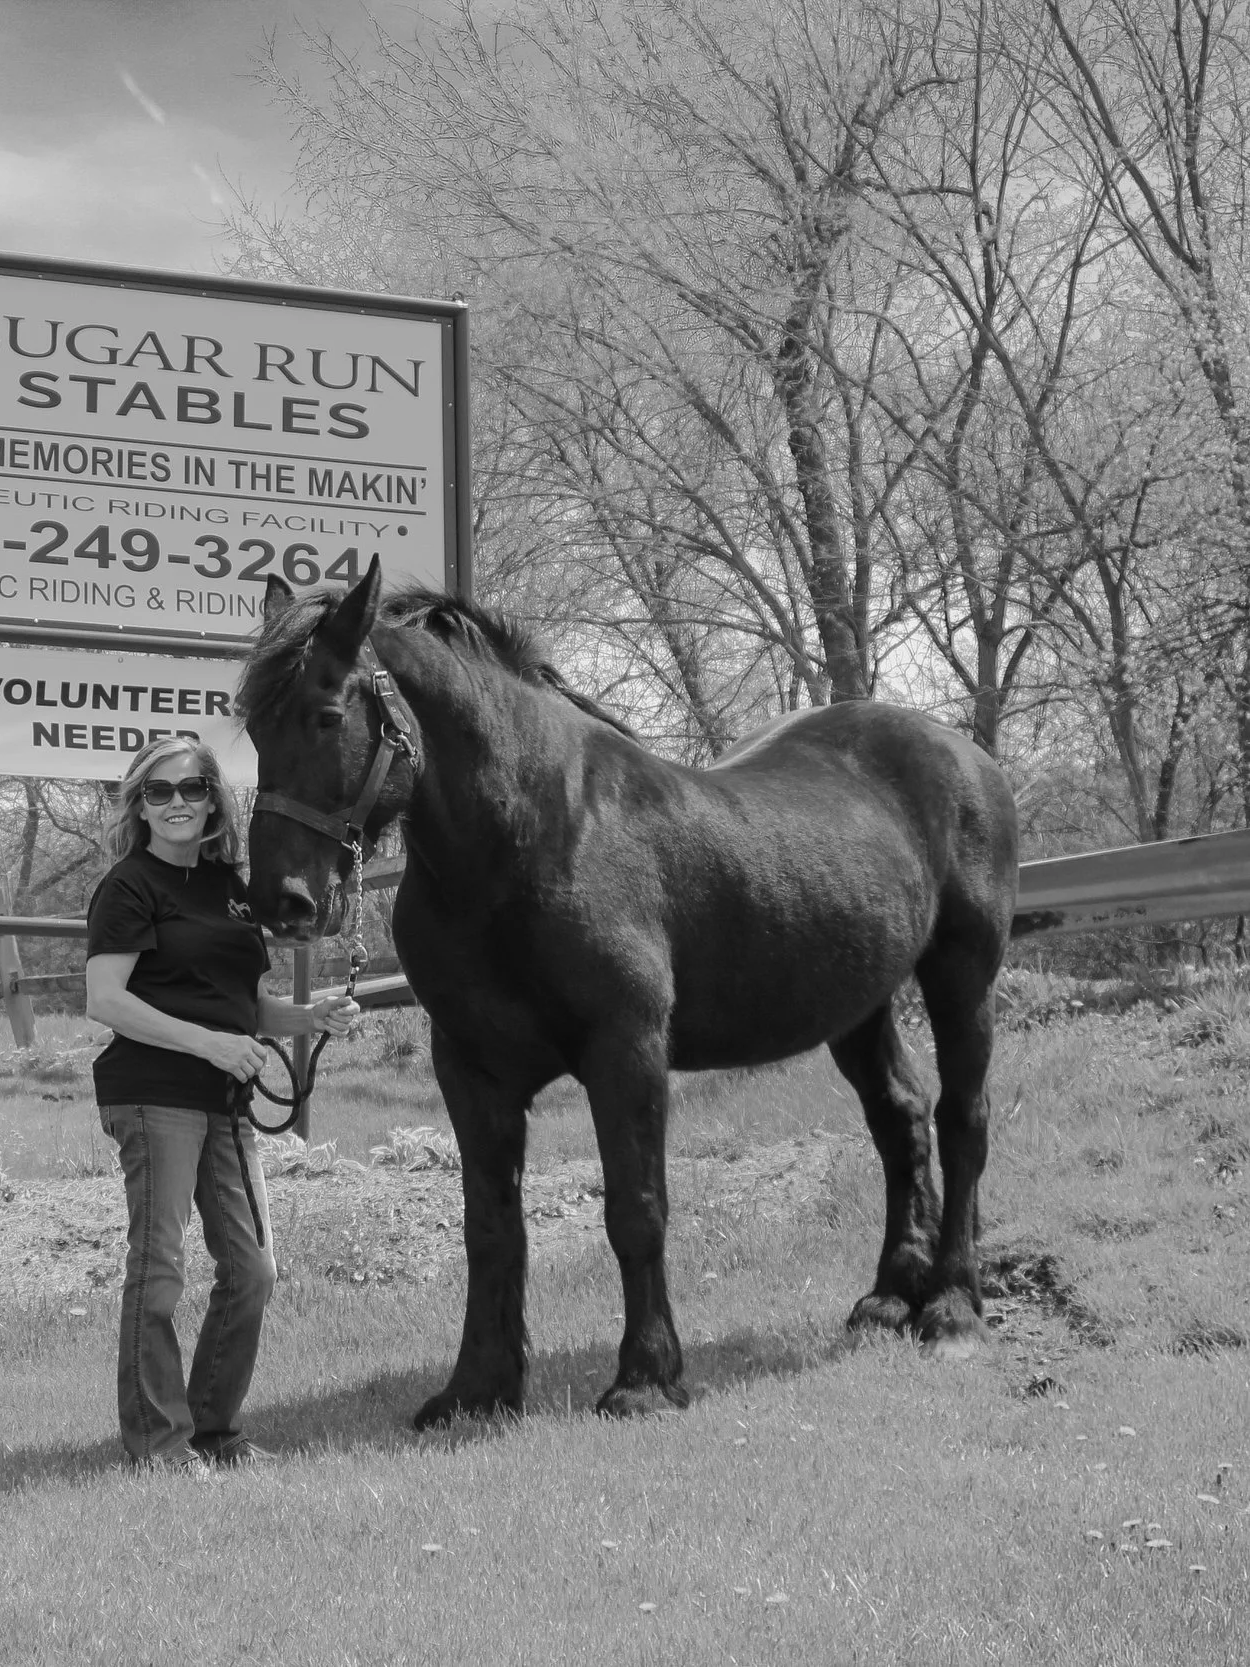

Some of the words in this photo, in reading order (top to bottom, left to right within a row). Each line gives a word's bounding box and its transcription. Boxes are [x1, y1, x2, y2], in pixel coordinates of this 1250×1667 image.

[252, 342, 426, 397] RUN
[16, 370, 370, 439] STABLES
[184, 455, 215, 486] IN
[228, 459, 295, 494] THE
[308, 467, 427, 505] MAKIN'
[108, 499, 229, 524] RIDING
[242, 511, 390, 538] FACILITY
[29, 577, 136, 607] RIDING
[146, 587, 166, 611] &
[176, 588, 265, 618] RIDIN
[32, 721, 201, 752] NEED
